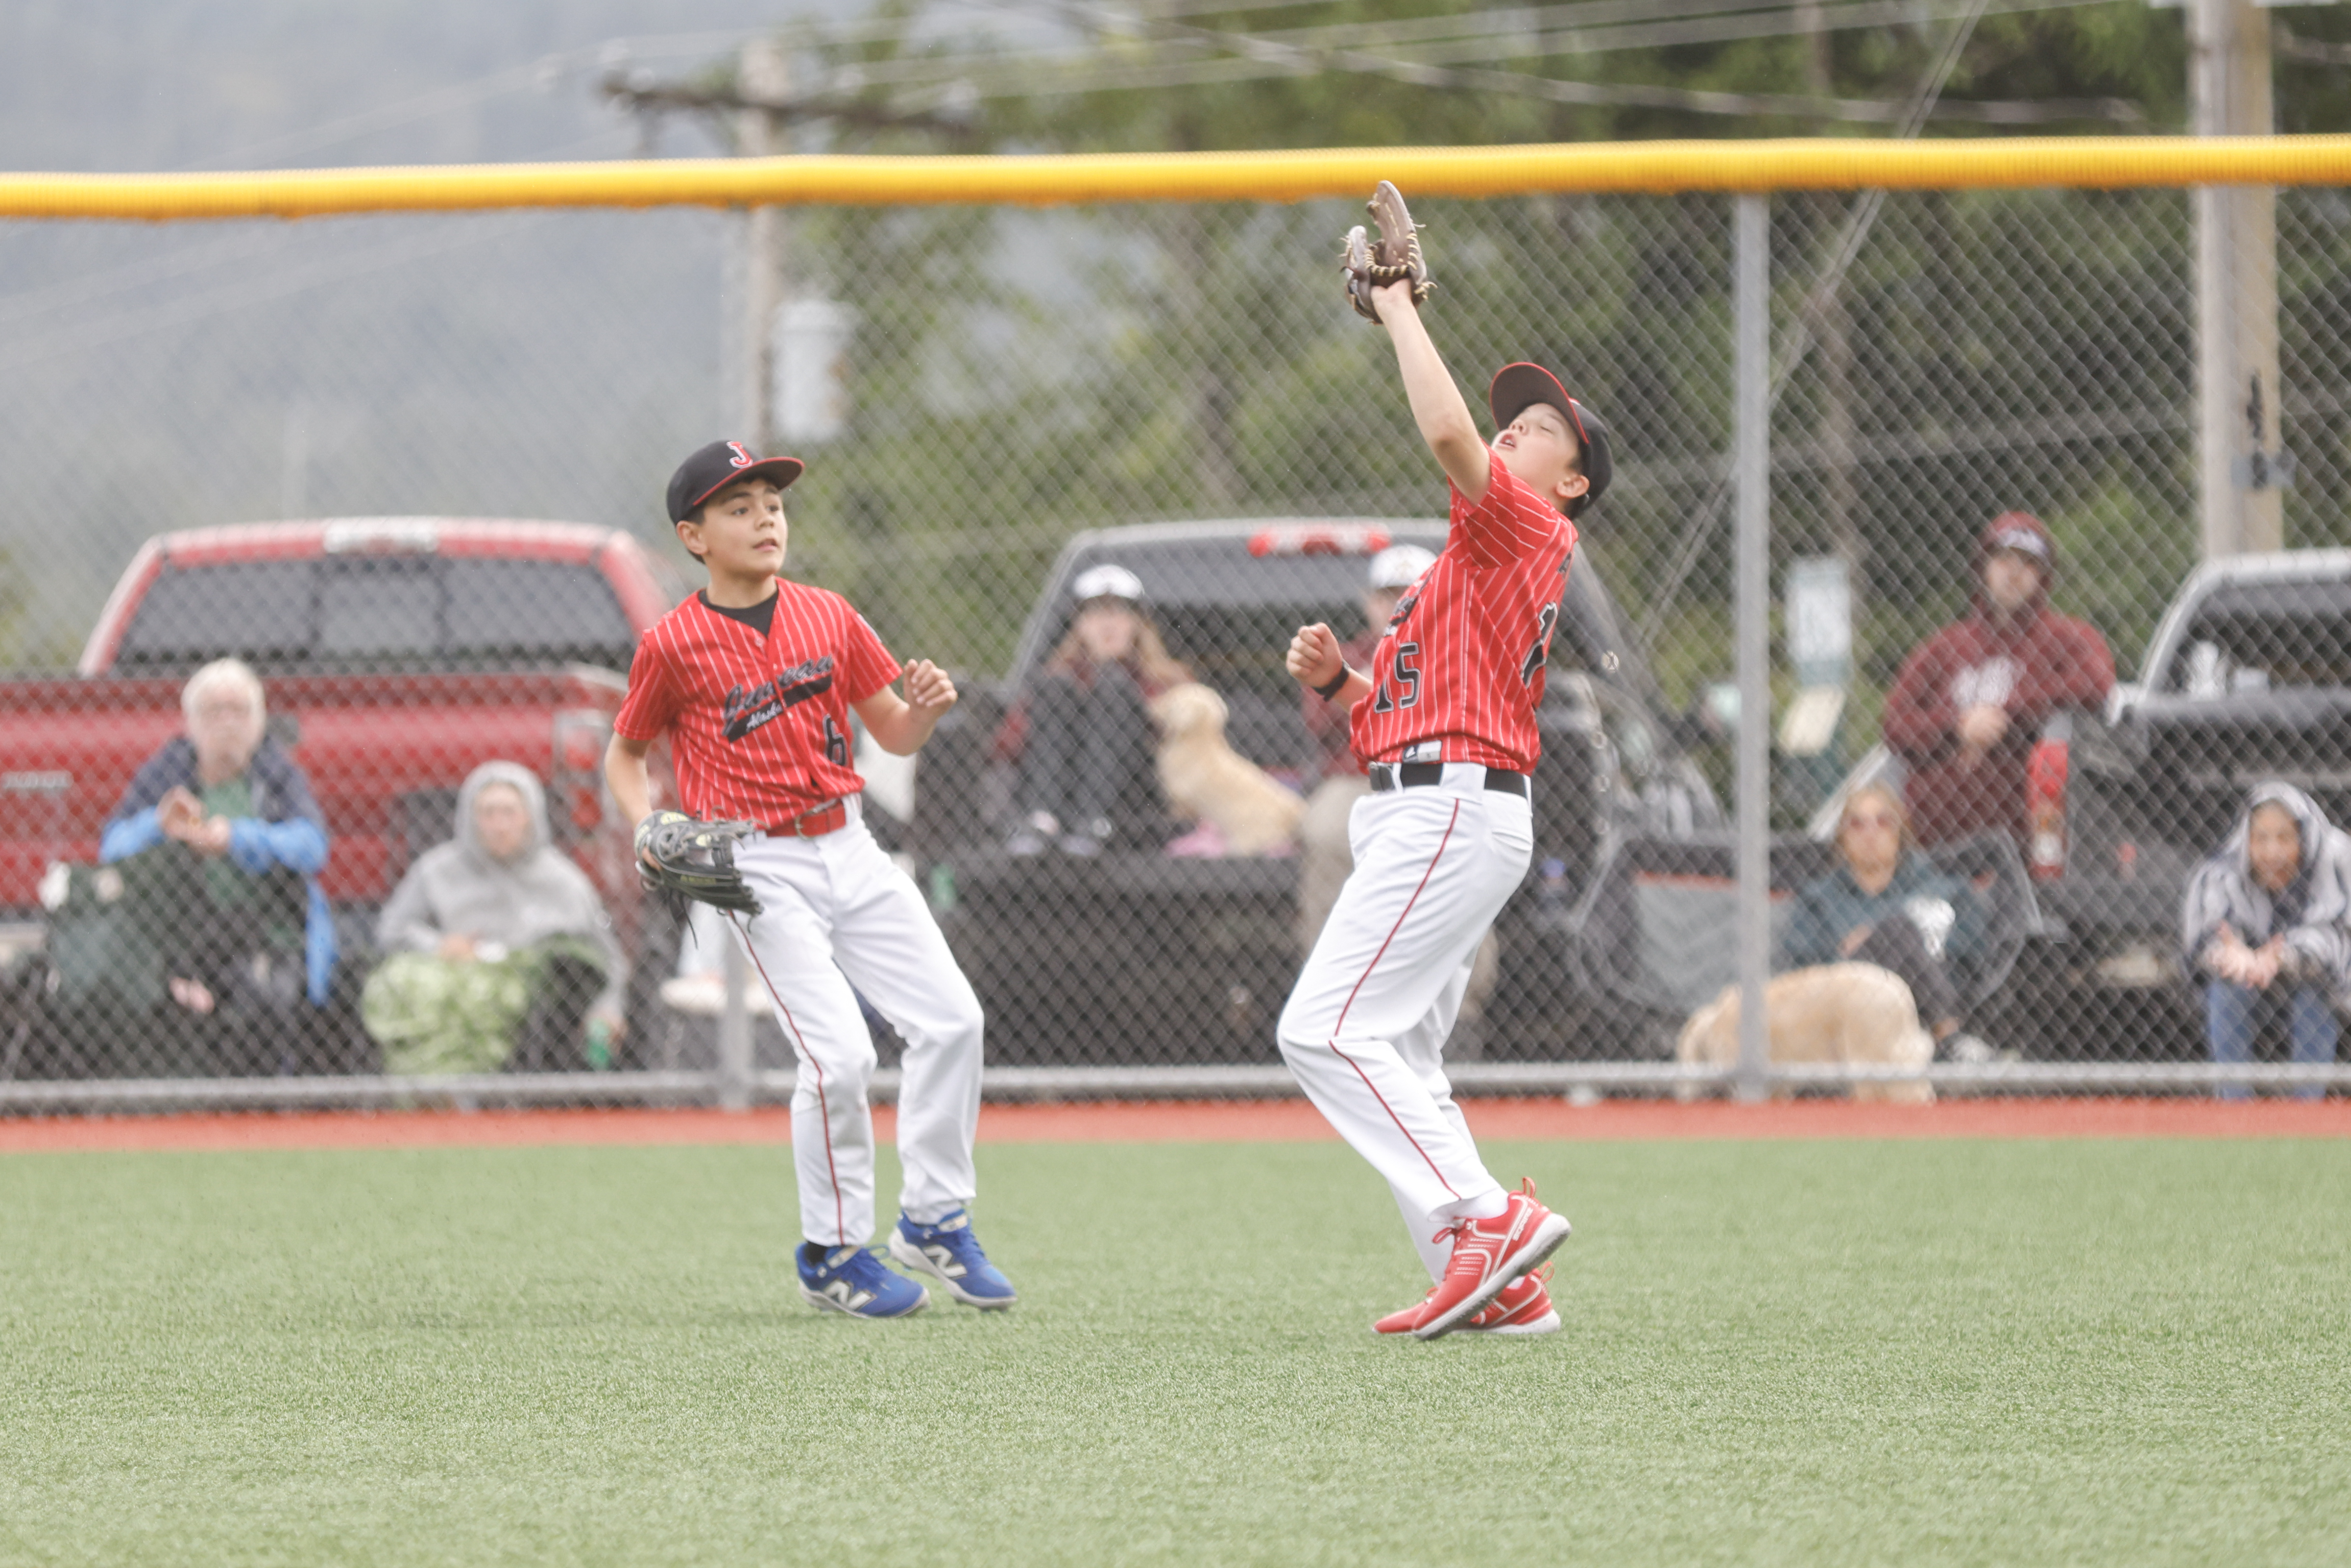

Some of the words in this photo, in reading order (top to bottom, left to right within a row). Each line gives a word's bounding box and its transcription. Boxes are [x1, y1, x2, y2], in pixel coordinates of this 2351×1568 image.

[726, 441, 754, 469] J
[1373, 641, 1421, 714] 15
[822, 713, 849, 767] 6
